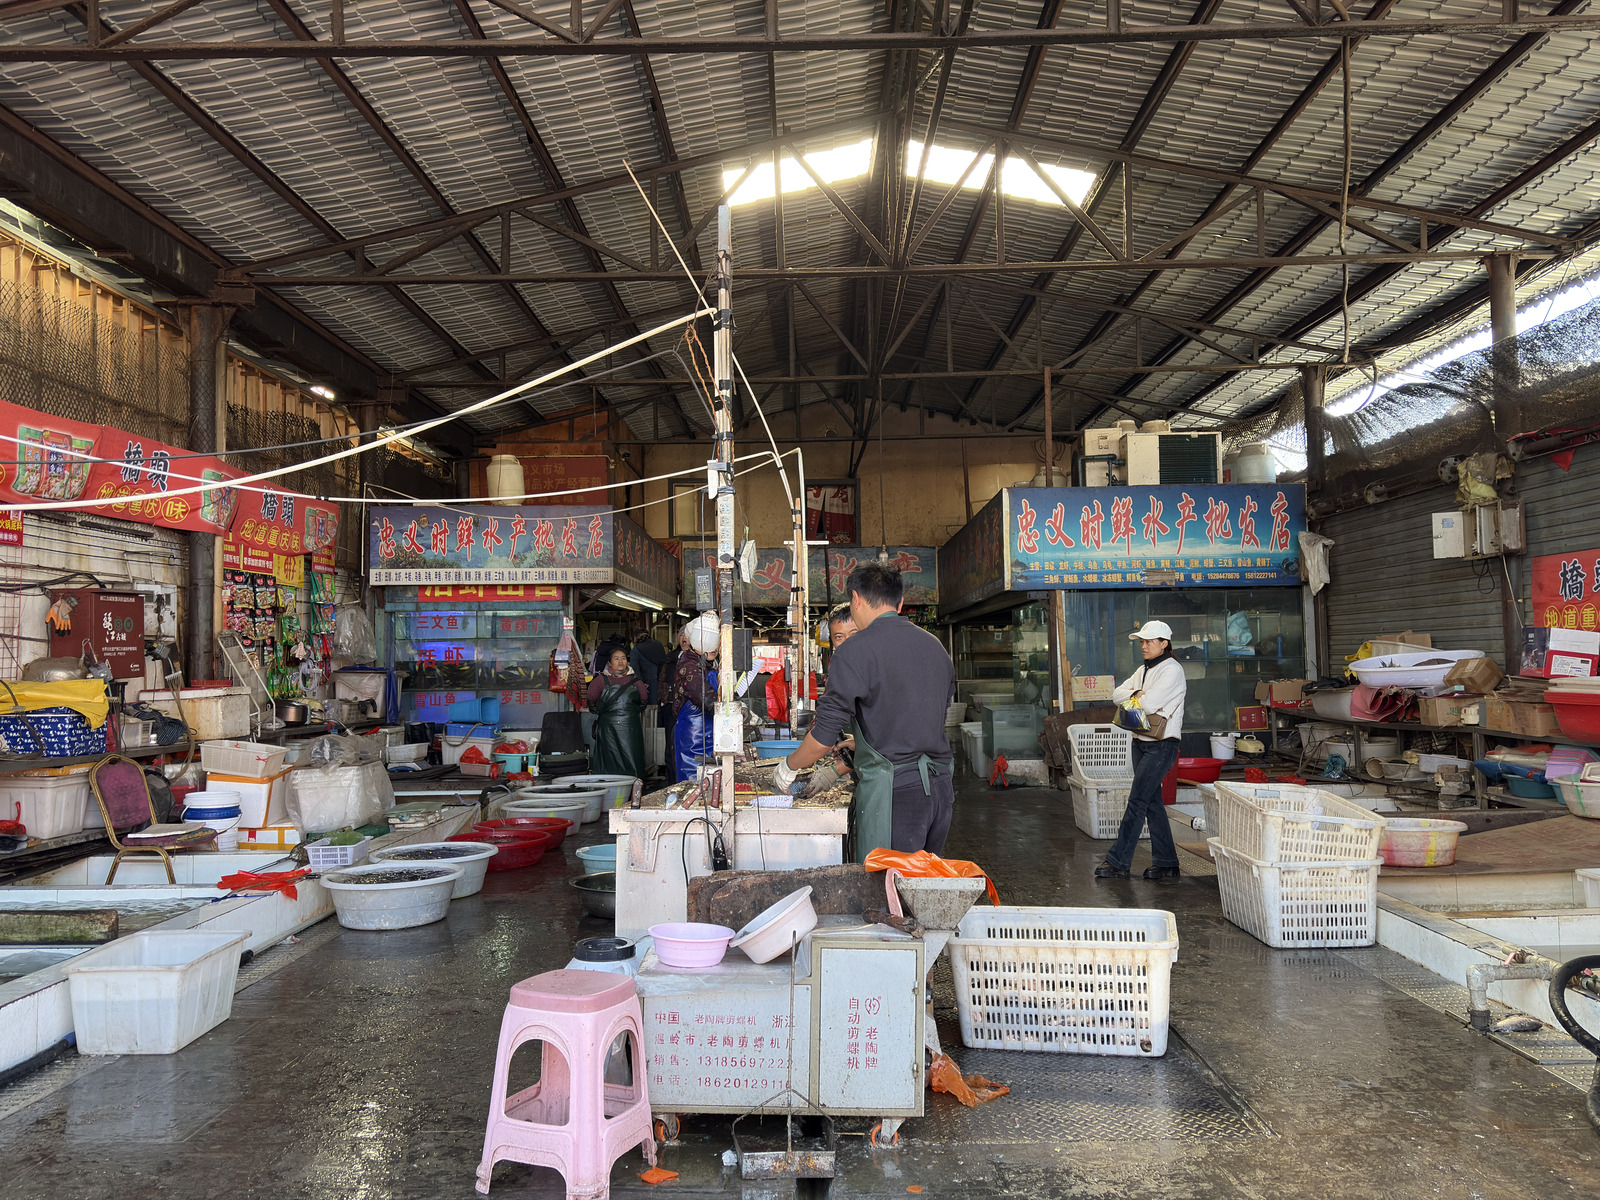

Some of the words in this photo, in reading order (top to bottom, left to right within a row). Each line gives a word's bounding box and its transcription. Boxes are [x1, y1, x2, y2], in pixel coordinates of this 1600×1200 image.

[121, 440, 170, 492] 橋頭
[261, 486, 295, 529] 橋頭
[240, 519, 301, 552] 地道重庆味
[379, 514, 603, 561] 忠义时鲜水产批发店
[1017, 491, 1290, 556] 忠义时鲜水产批发店
[416, 615, 459, 630] 三文鱼
[500, 617, 543, 633] 黄辣丁
[1545, 604, 1600, 630] 地道重
[416, 647, 464, 669] 活虾
[414, 692, 456, 708] 雪山鱼
[501, 690, 543, 705] 罗非鱼
[655, 1011, 680, 1025] 中国
[695, 1014, 757, 1025] 老陶牌剪螺机
[772, 1015, 795, 1029] 浙江
[847, 997, 860, 1070] 自动剪螺机
[865, 1026, 878, 1069] 老陶牌
